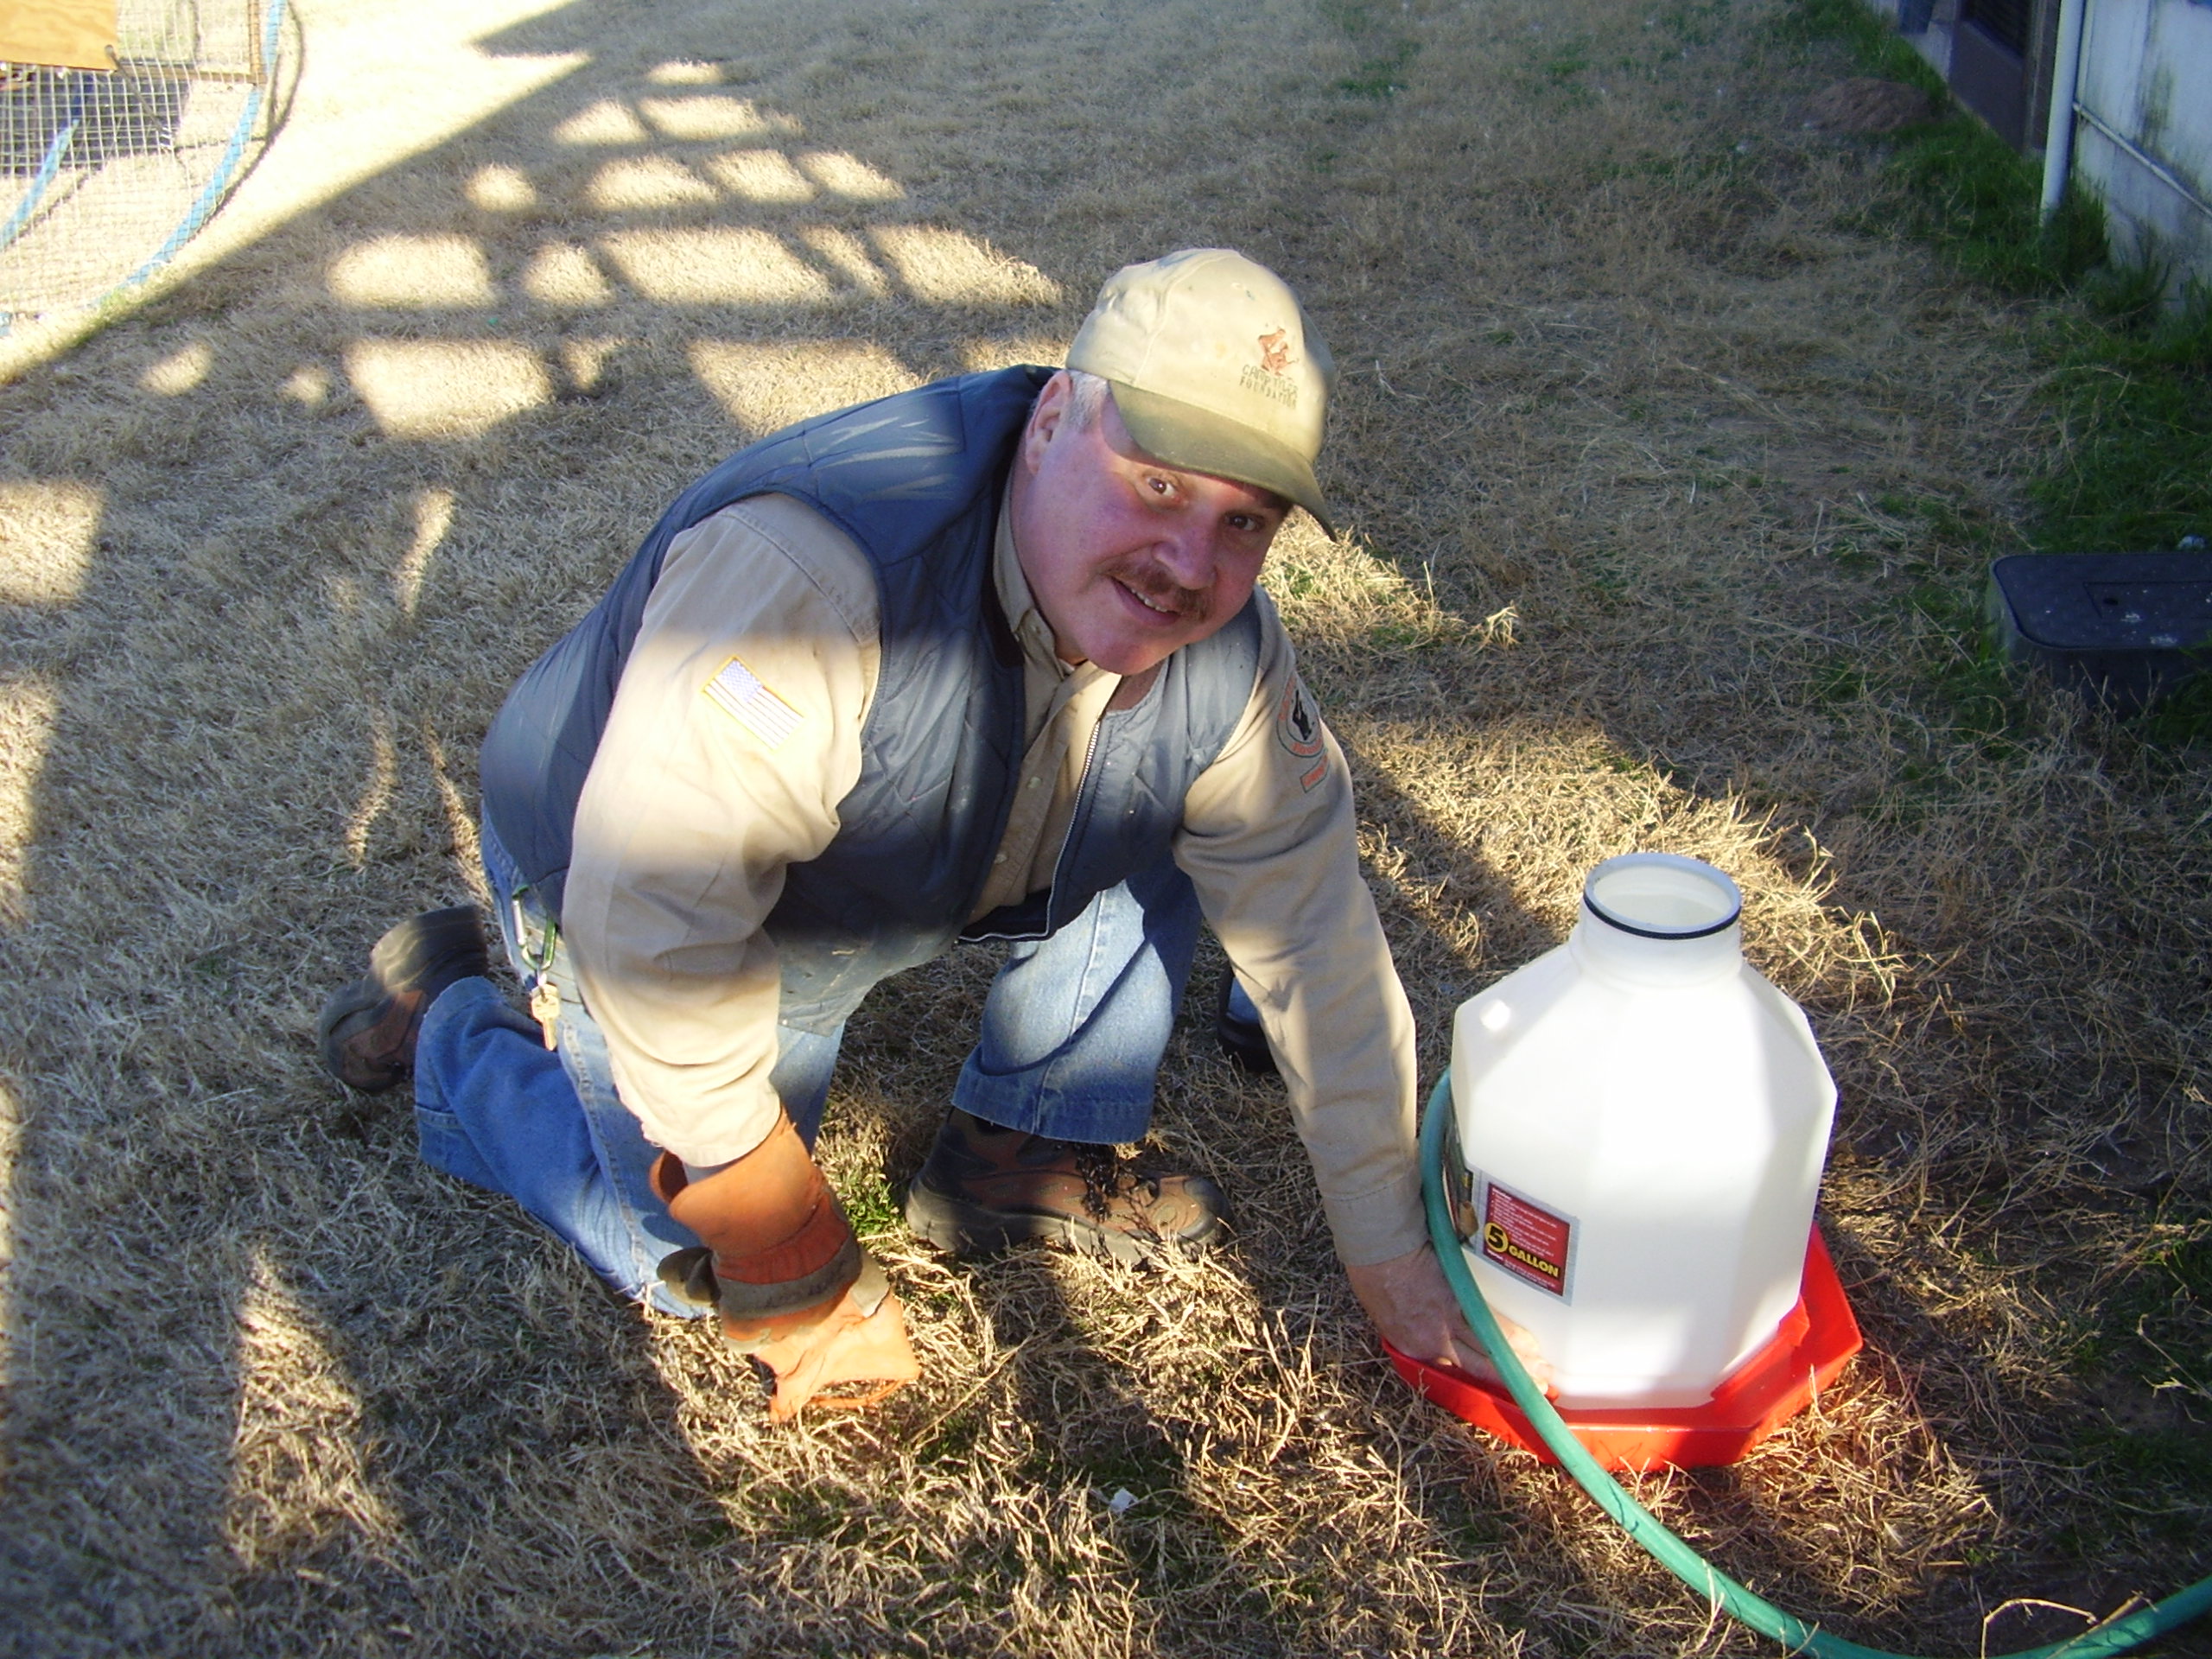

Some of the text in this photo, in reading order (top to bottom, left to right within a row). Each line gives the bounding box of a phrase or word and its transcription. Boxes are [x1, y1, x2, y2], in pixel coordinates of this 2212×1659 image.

[1243, 364, 1271, 386] CAMP
[1239, 376, 1297, 410] FOUNDATION
[1488, 1225, 1504, 1249] 5
[1509, 1245, 1559, 1277] GALLON
